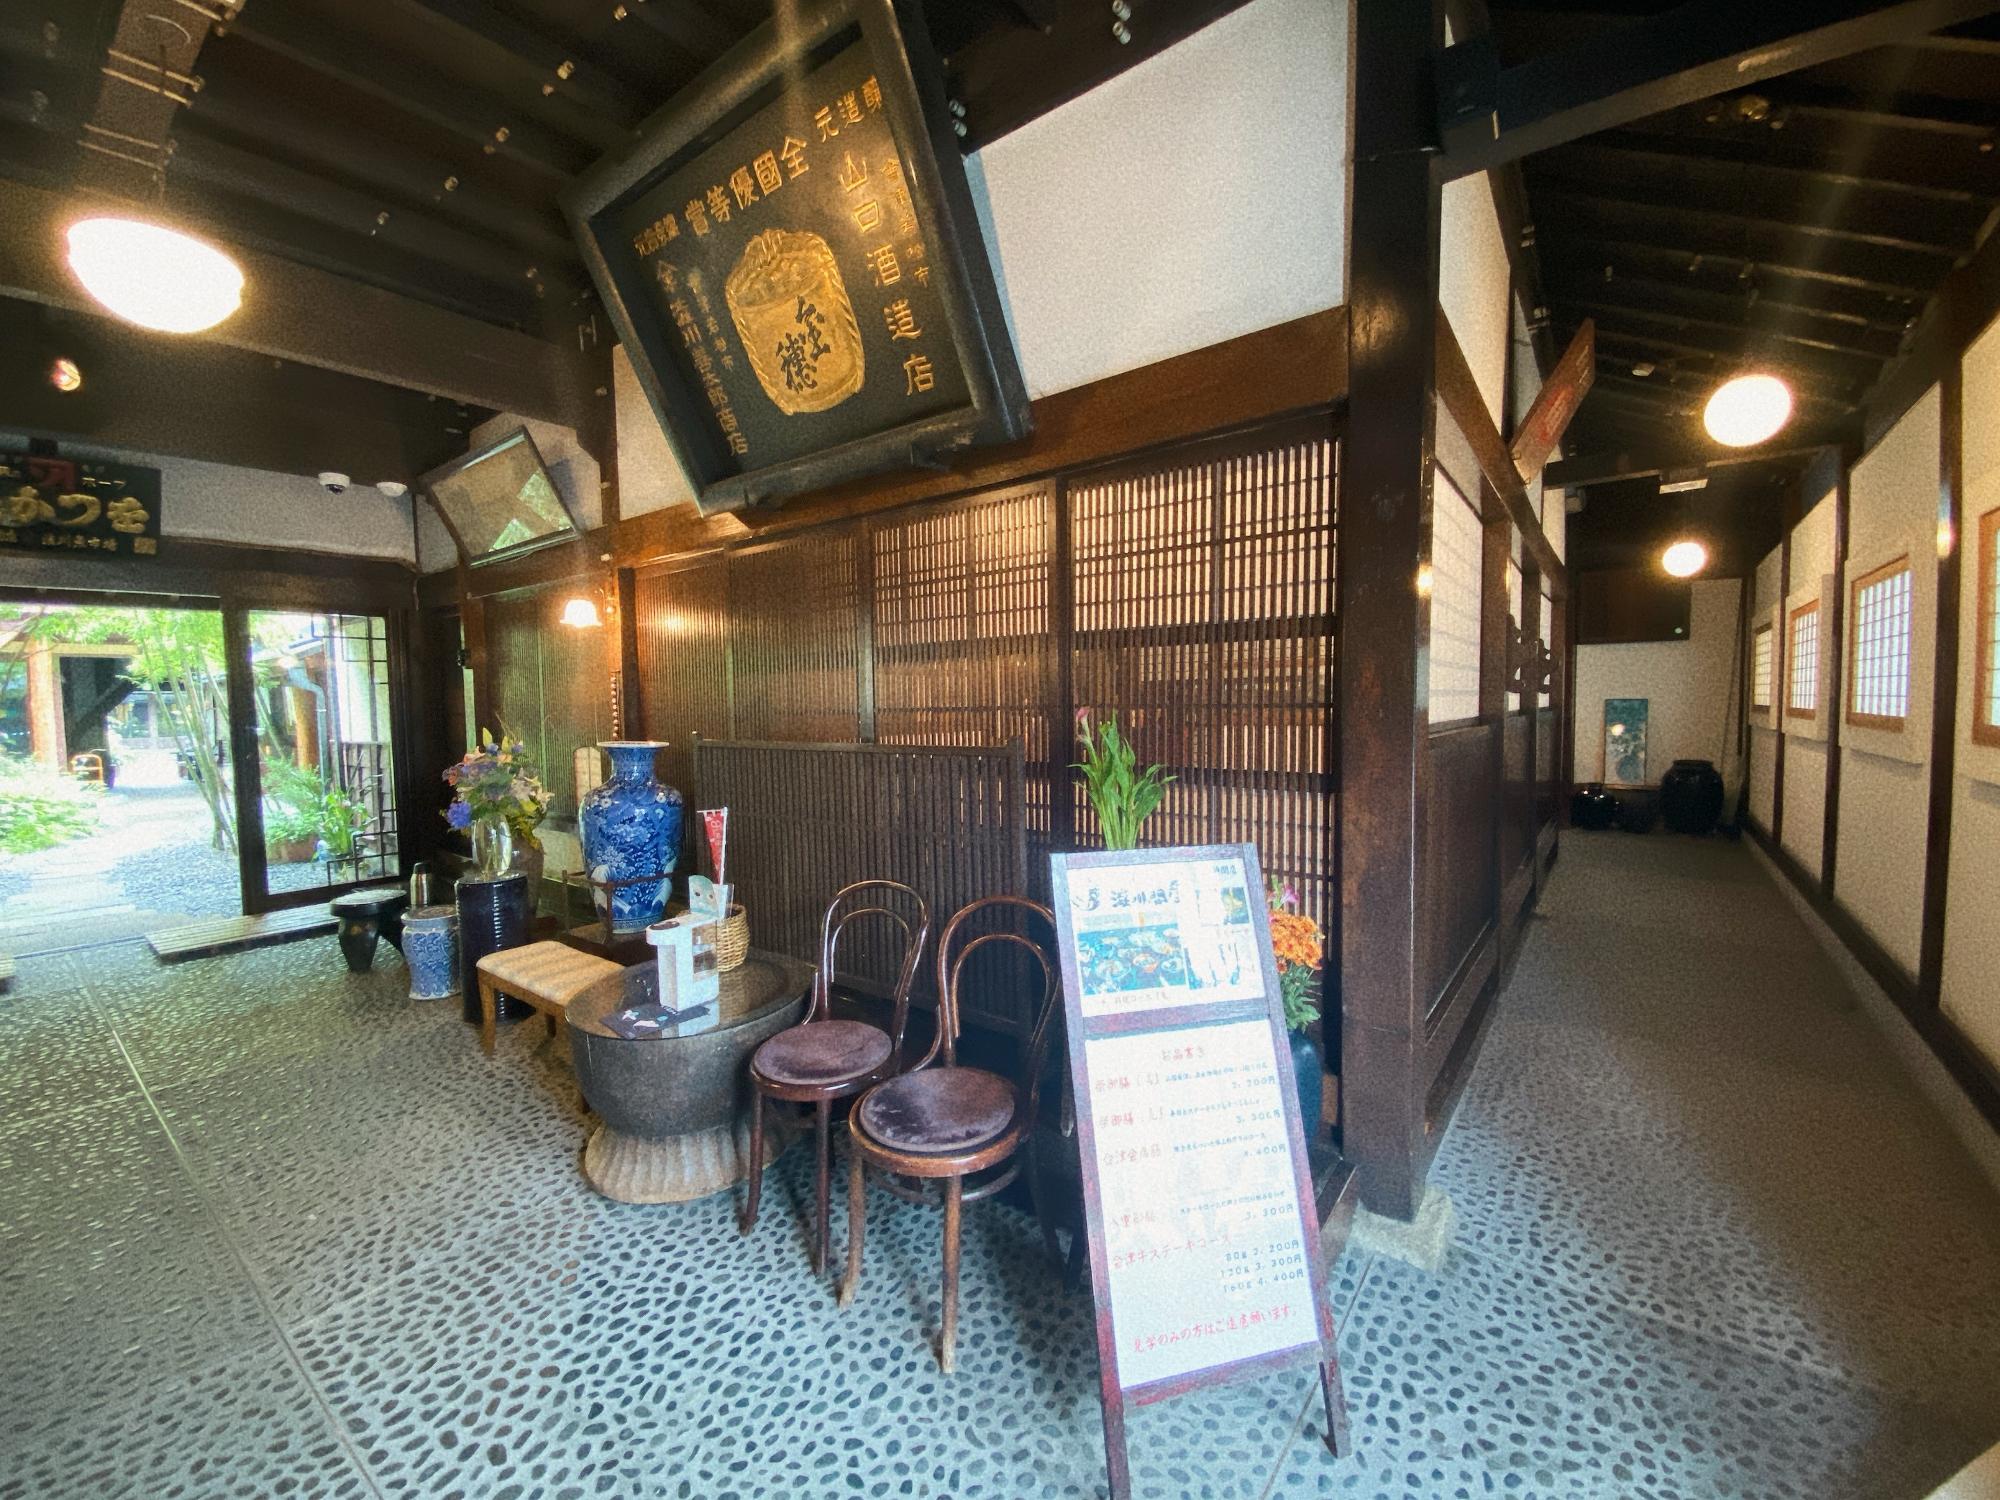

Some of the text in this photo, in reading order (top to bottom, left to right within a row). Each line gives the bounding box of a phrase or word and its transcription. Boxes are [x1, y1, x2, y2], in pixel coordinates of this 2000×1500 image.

[839, 150, 936, 397] 山口酒造店
[1160, 1044, 1206, 1062] お品書き
